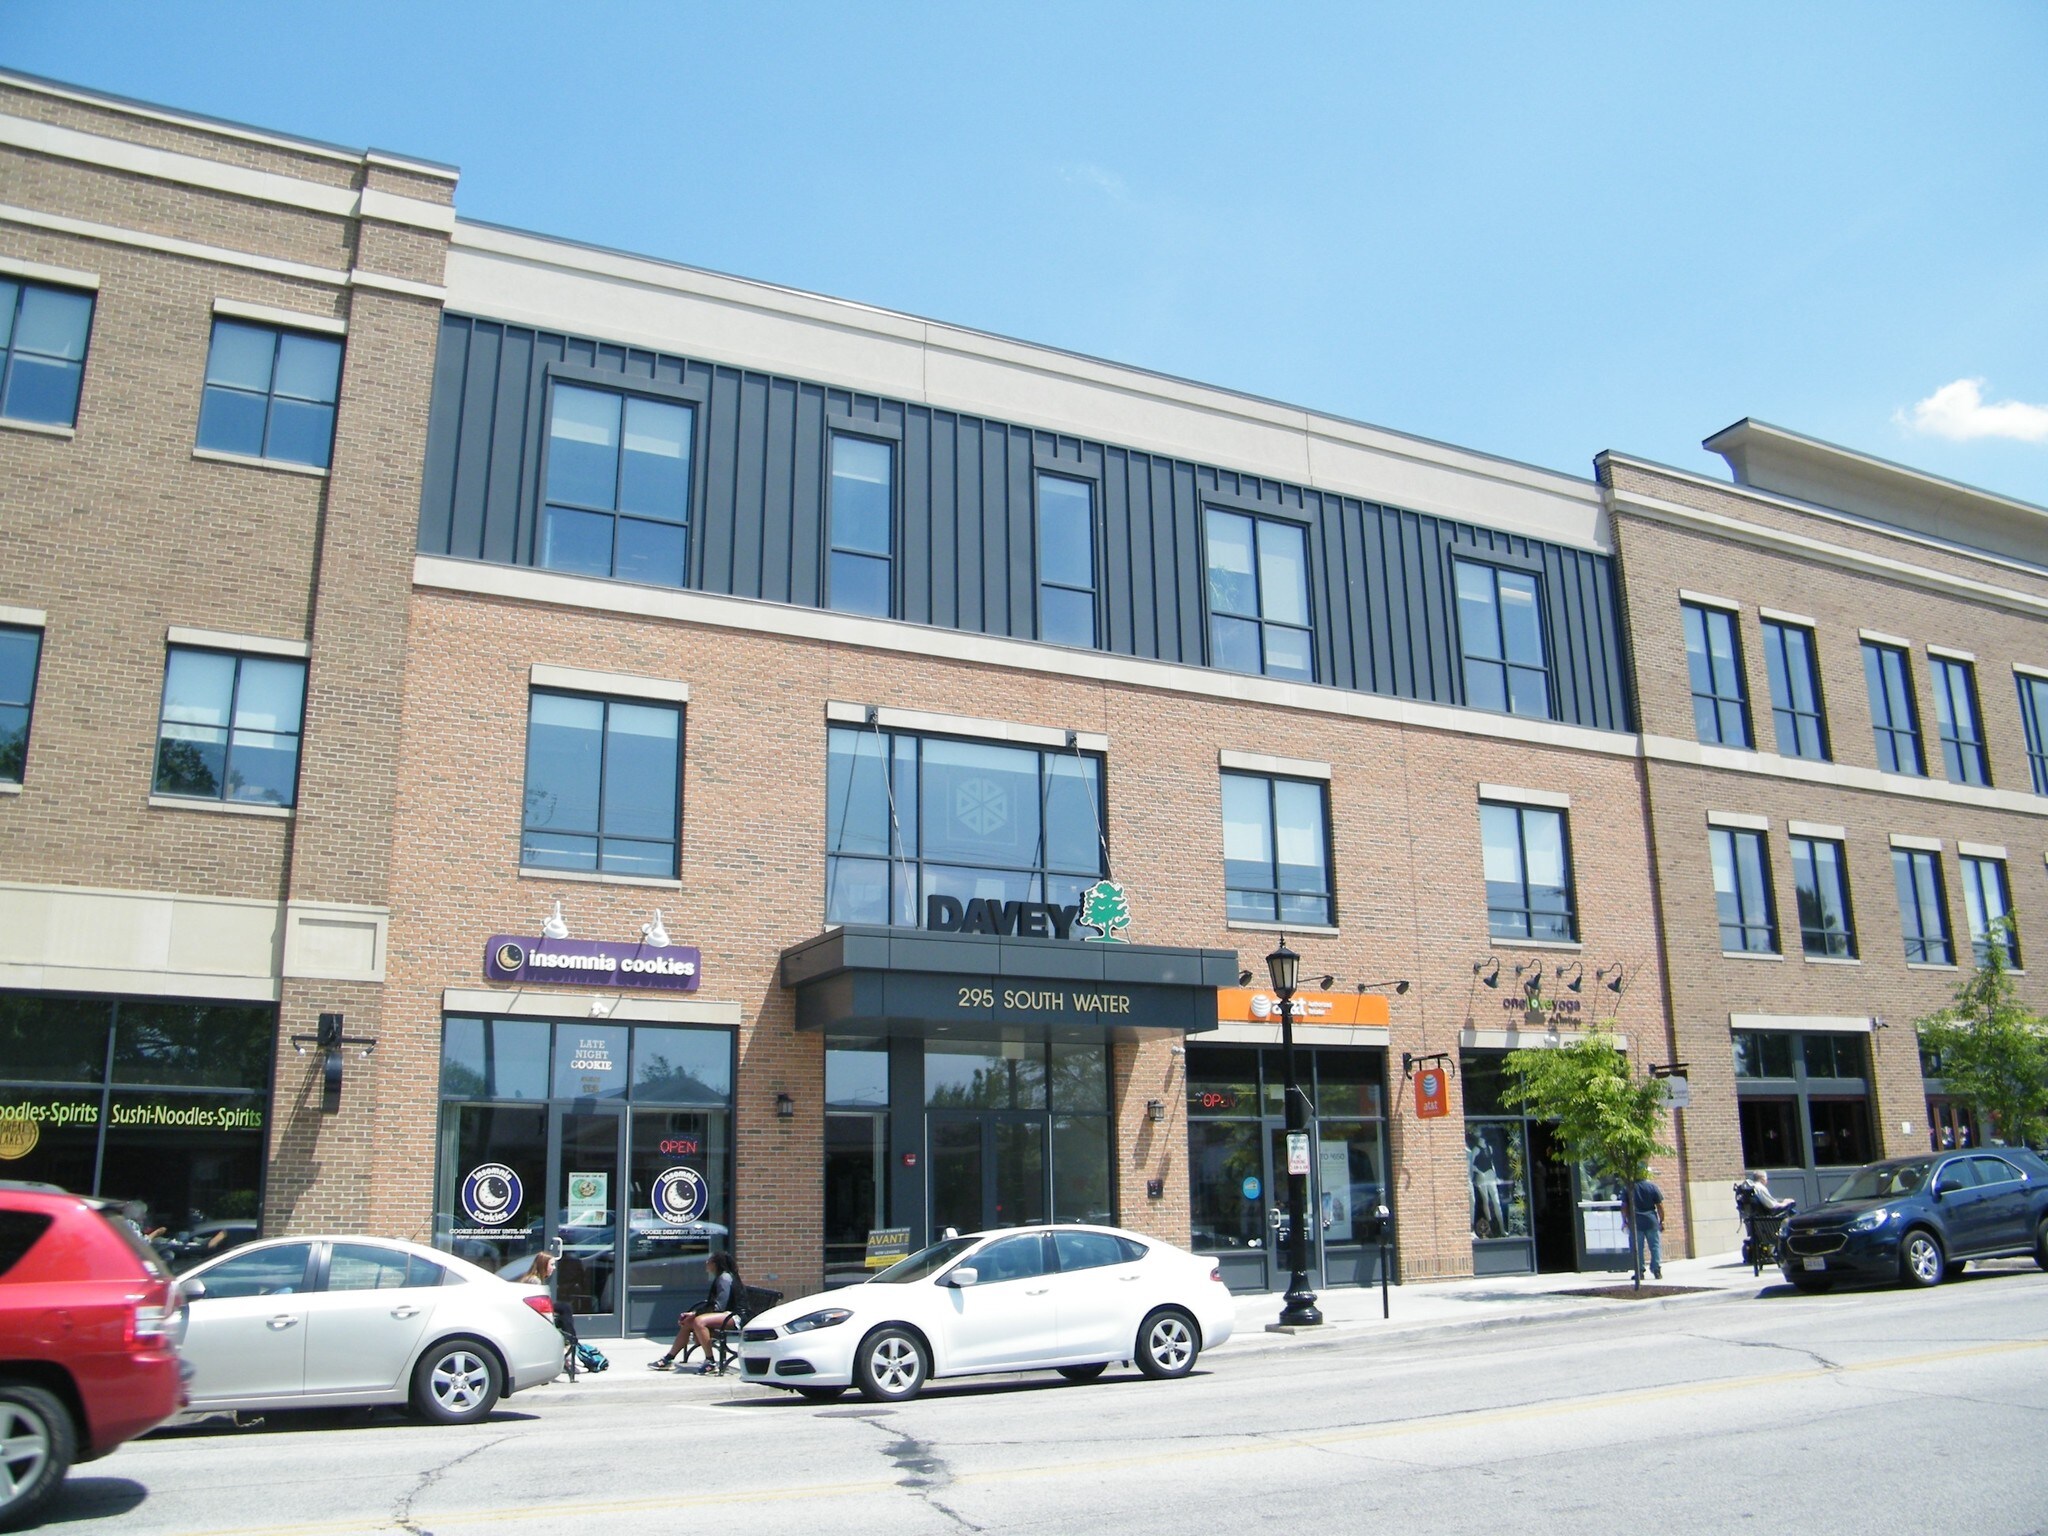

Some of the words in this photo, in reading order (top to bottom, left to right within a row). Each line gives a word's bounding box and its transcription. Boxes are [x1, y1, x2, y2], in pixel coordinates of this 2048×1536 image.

[927, 894, 1080, 940] DAVEY
[529, 949, 616, 972] insomnia
[620, 957, 695, 976] cookies
[958, 987, 994, 1008] 295
[1003, 989, 1064, 1011] SOUTH
[1072, 993, 1130, 1014] WATER
[1271, 998, 1307, 1015] a&t
[579, 1040, 605, 1049] LATE
[575, 1050, 609, 1059] NIGHT
[570, 1060, 612, 1070] COOKIE
[660, 1140, 697, 1153] OPEN
[472, 1167, 512, 1181] insomnia
[474, 1210, 508, 1222] cookies
[868, 1233, 904, 1245] AVANT
